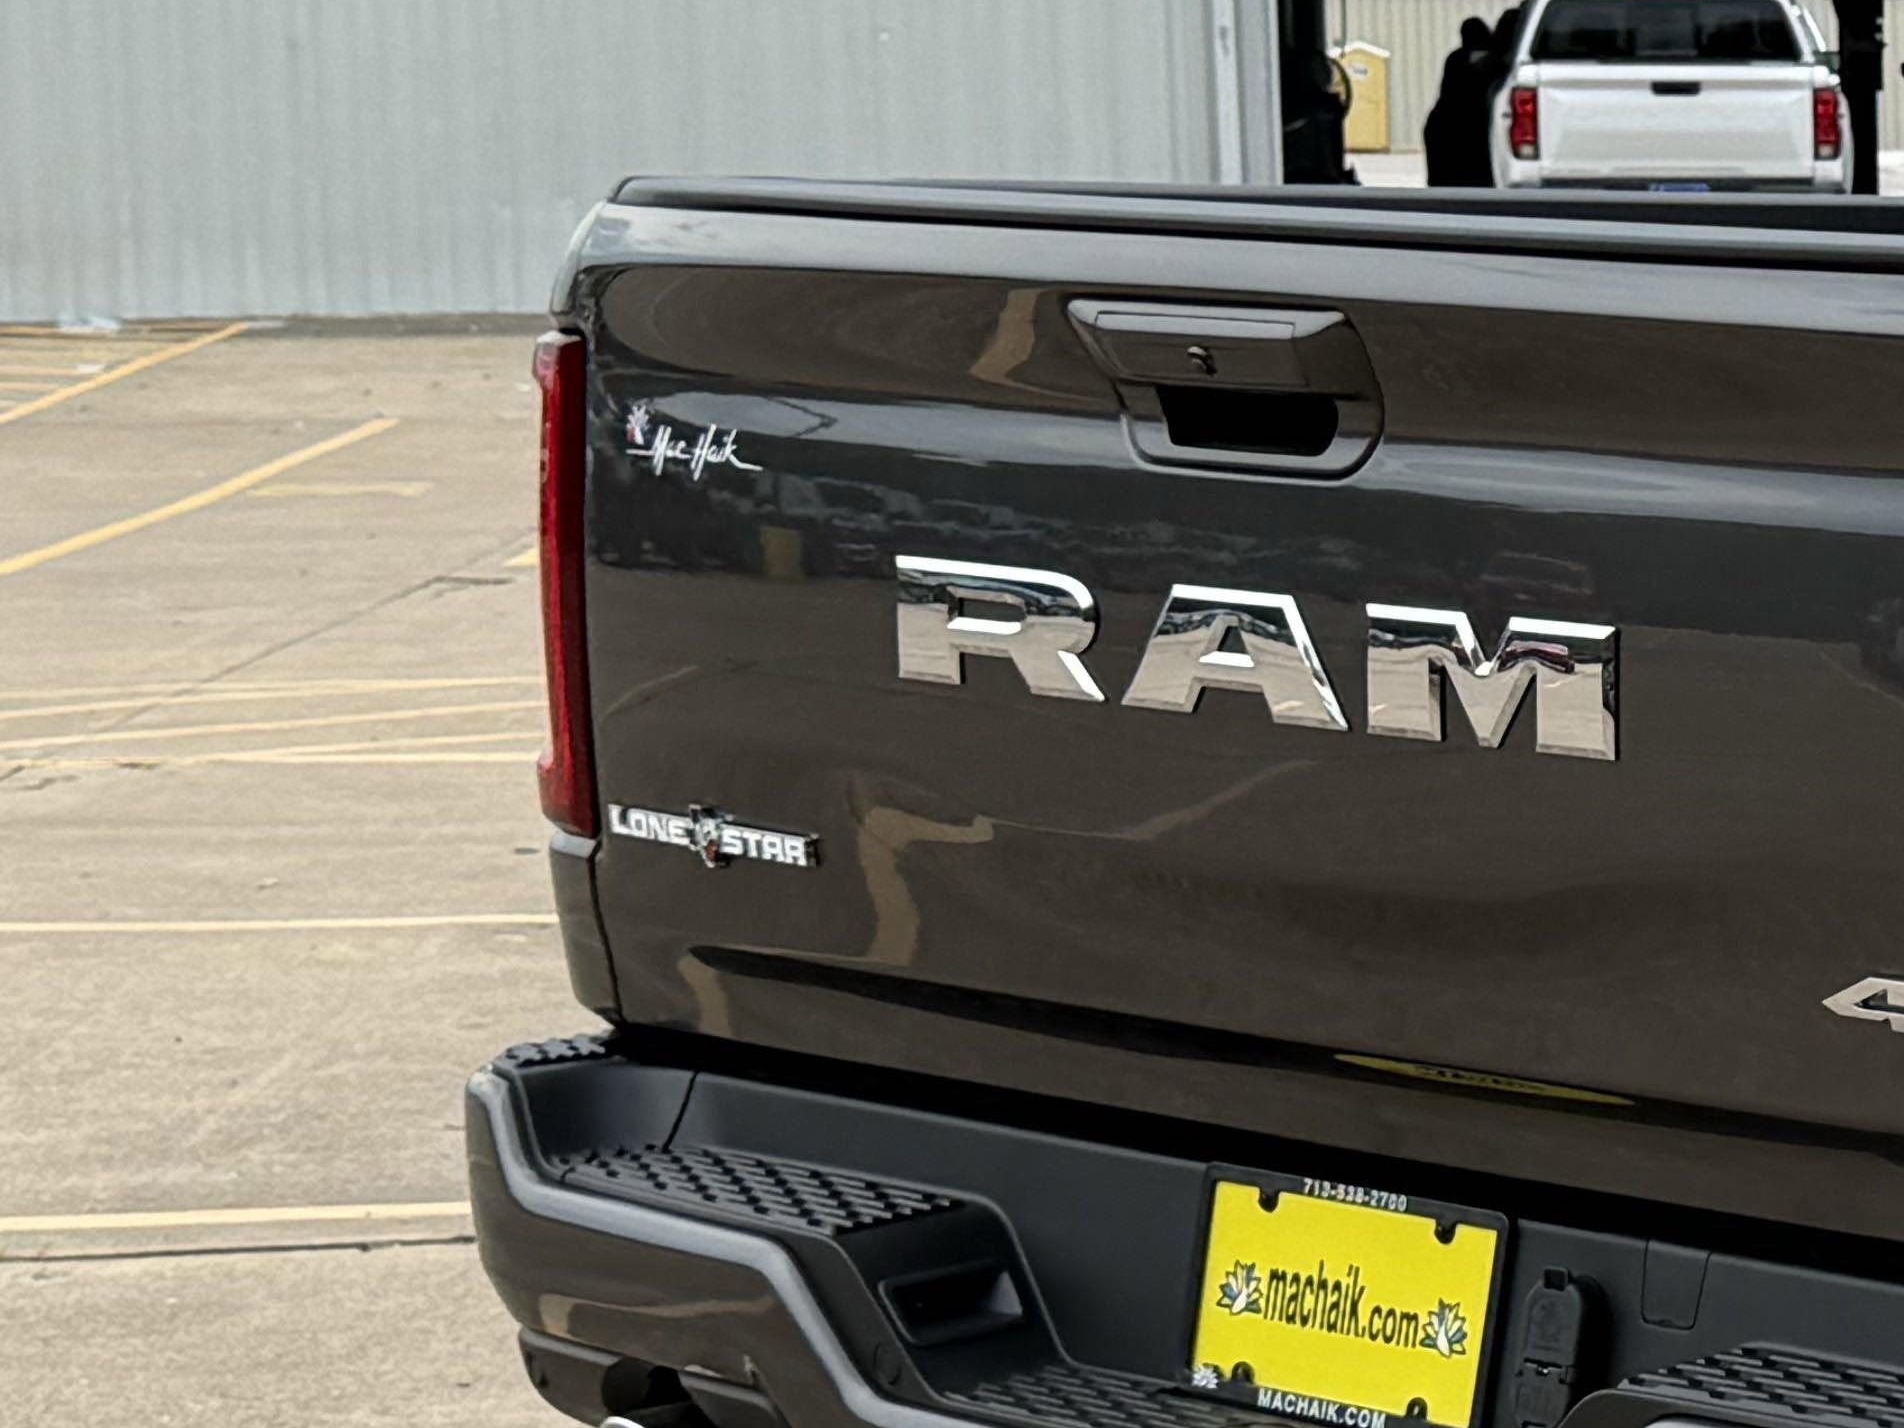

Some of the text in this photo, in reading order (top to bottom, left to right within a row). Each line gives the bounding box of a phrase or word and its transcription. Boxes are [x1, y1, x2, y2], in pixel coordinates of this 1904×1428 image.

[895, 555, 1618, 761] RAM
[607, 804, 808, 866] LONE STAR
[1263, 1259, 1421, 1349] machaik.com
